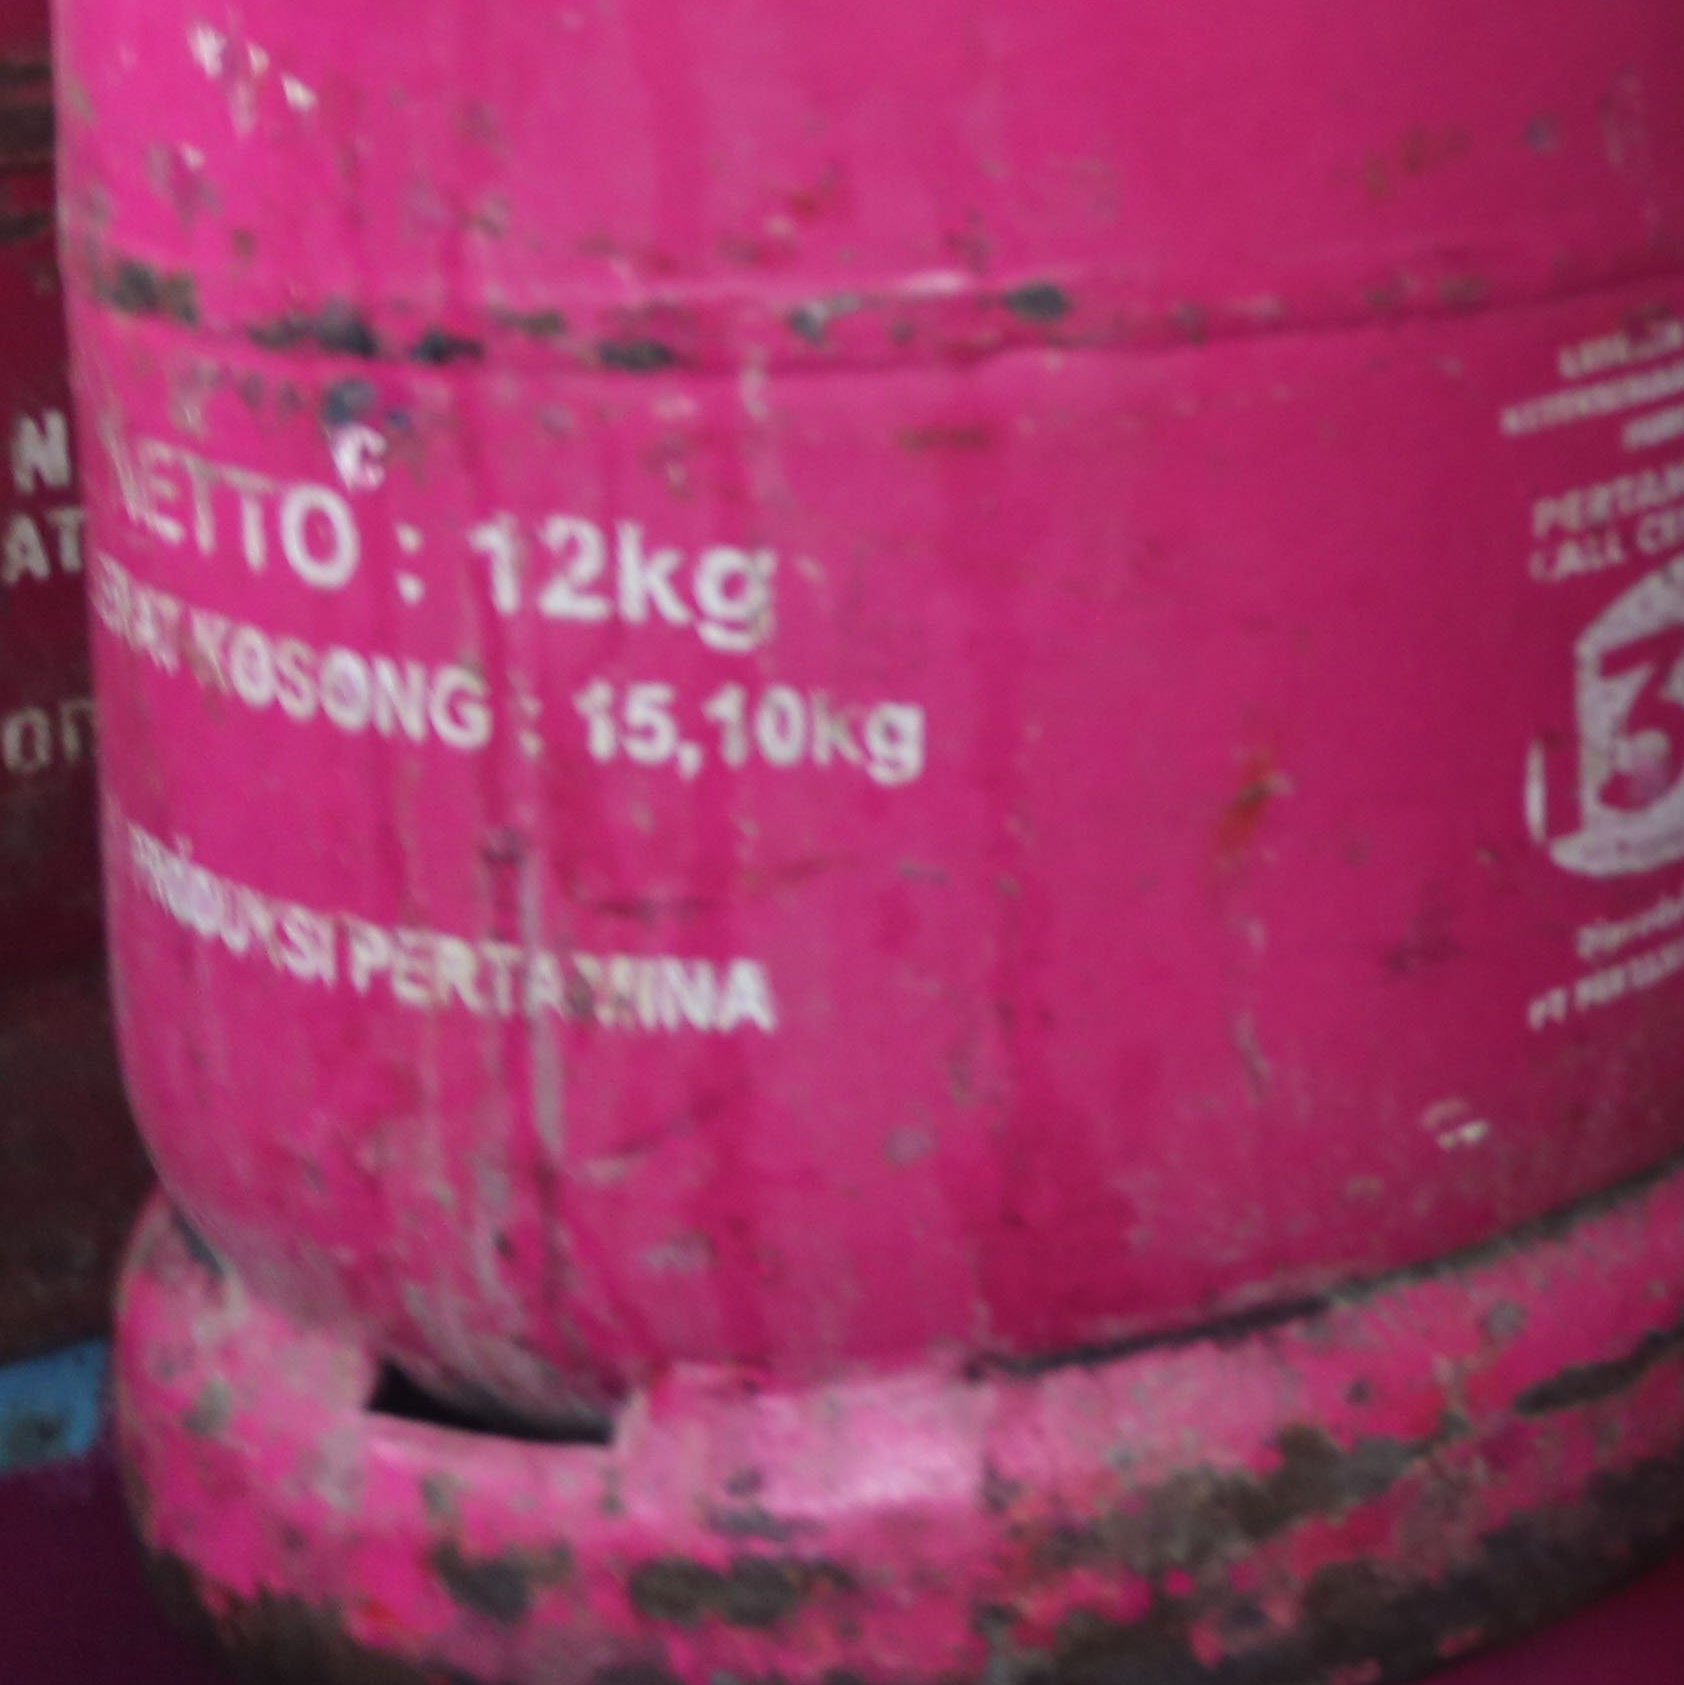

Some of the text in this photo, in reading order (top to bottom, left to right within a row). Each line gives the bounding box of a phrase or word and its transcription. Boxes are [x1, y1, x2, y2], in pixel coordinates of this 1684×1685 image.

[468, 511, 780, 653] 12kg
[574, 676, 927, 786] 15,10kg
[344, 914, 780, 1036] PERTAMINA
